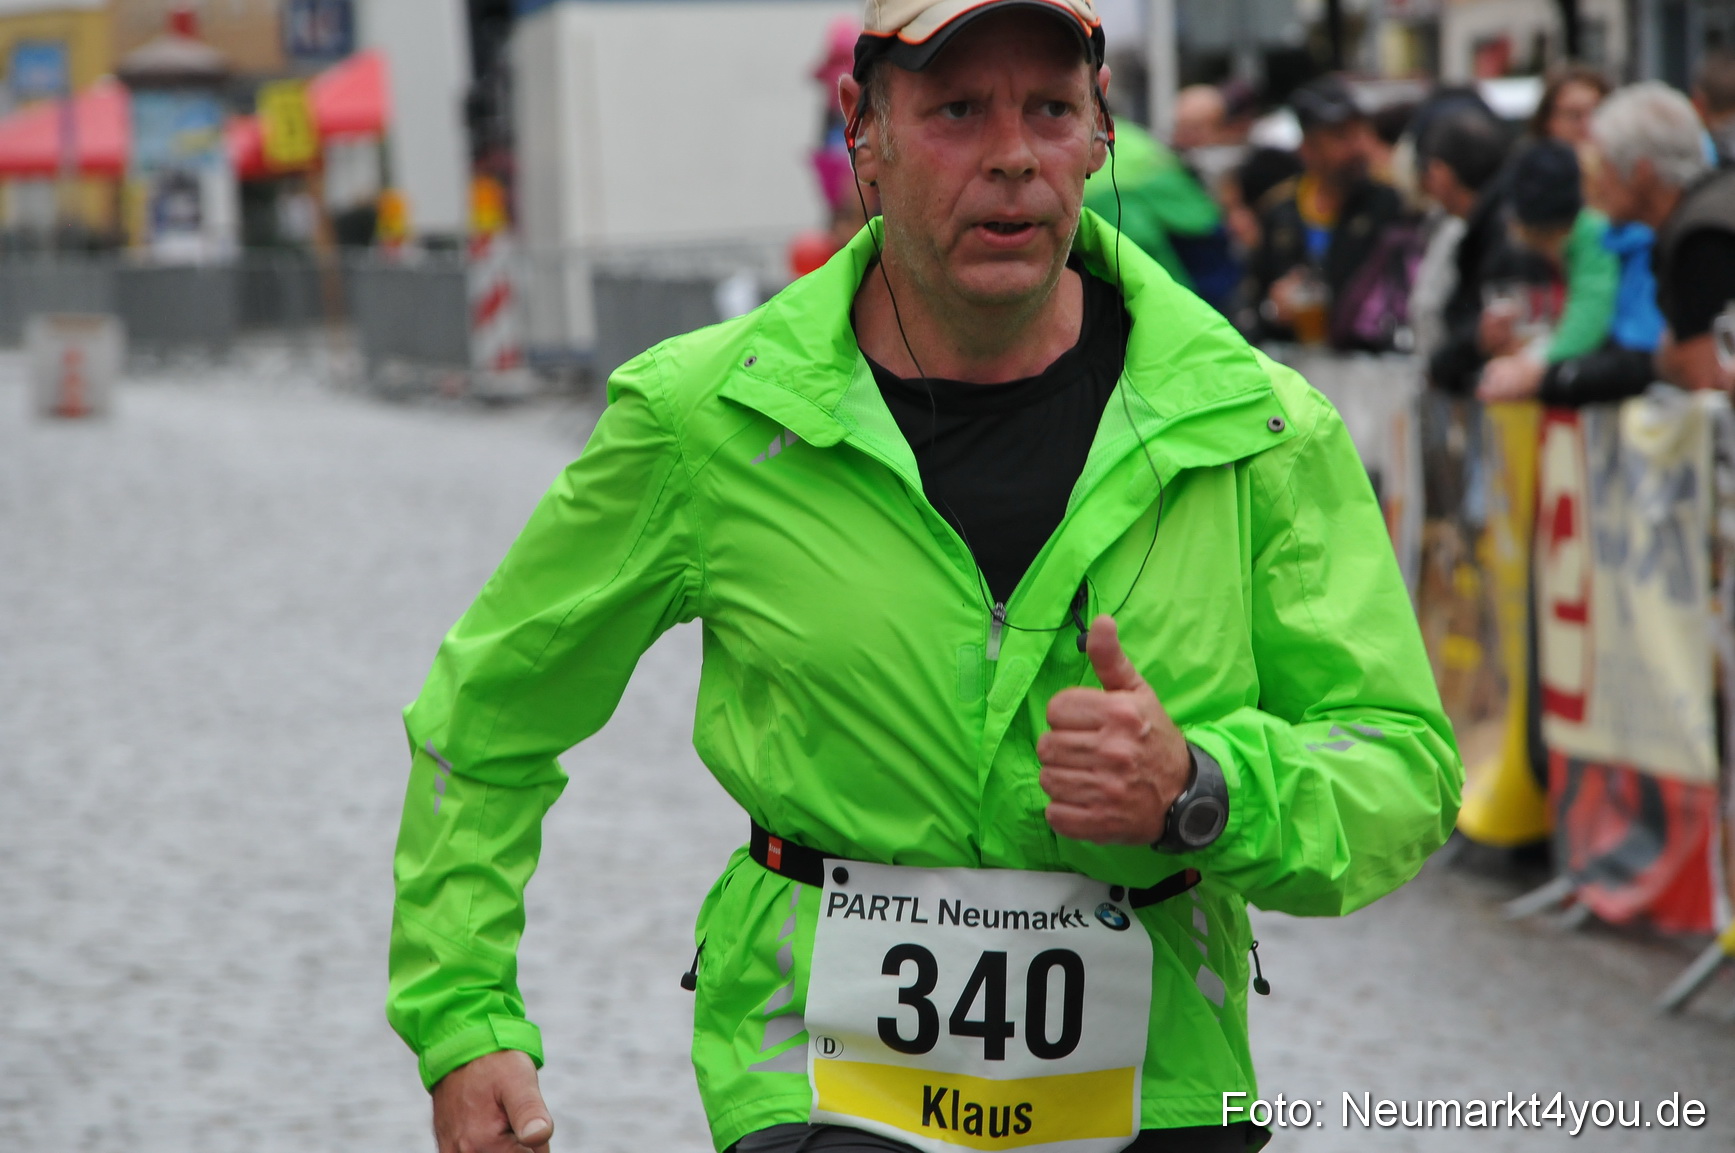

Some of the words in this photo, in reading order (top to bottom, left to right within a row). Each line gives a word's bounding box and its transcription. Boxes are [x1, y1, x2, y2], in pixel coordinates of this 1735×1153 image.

[826, 892, 928, 924] PARTL
[938, 898, 1089, 930] Neumarkt
[877, 943, 1085, 1061] 340
[823, 1037, 836, 1055] D
[921, 1085, 1033, 1137] Klaus
